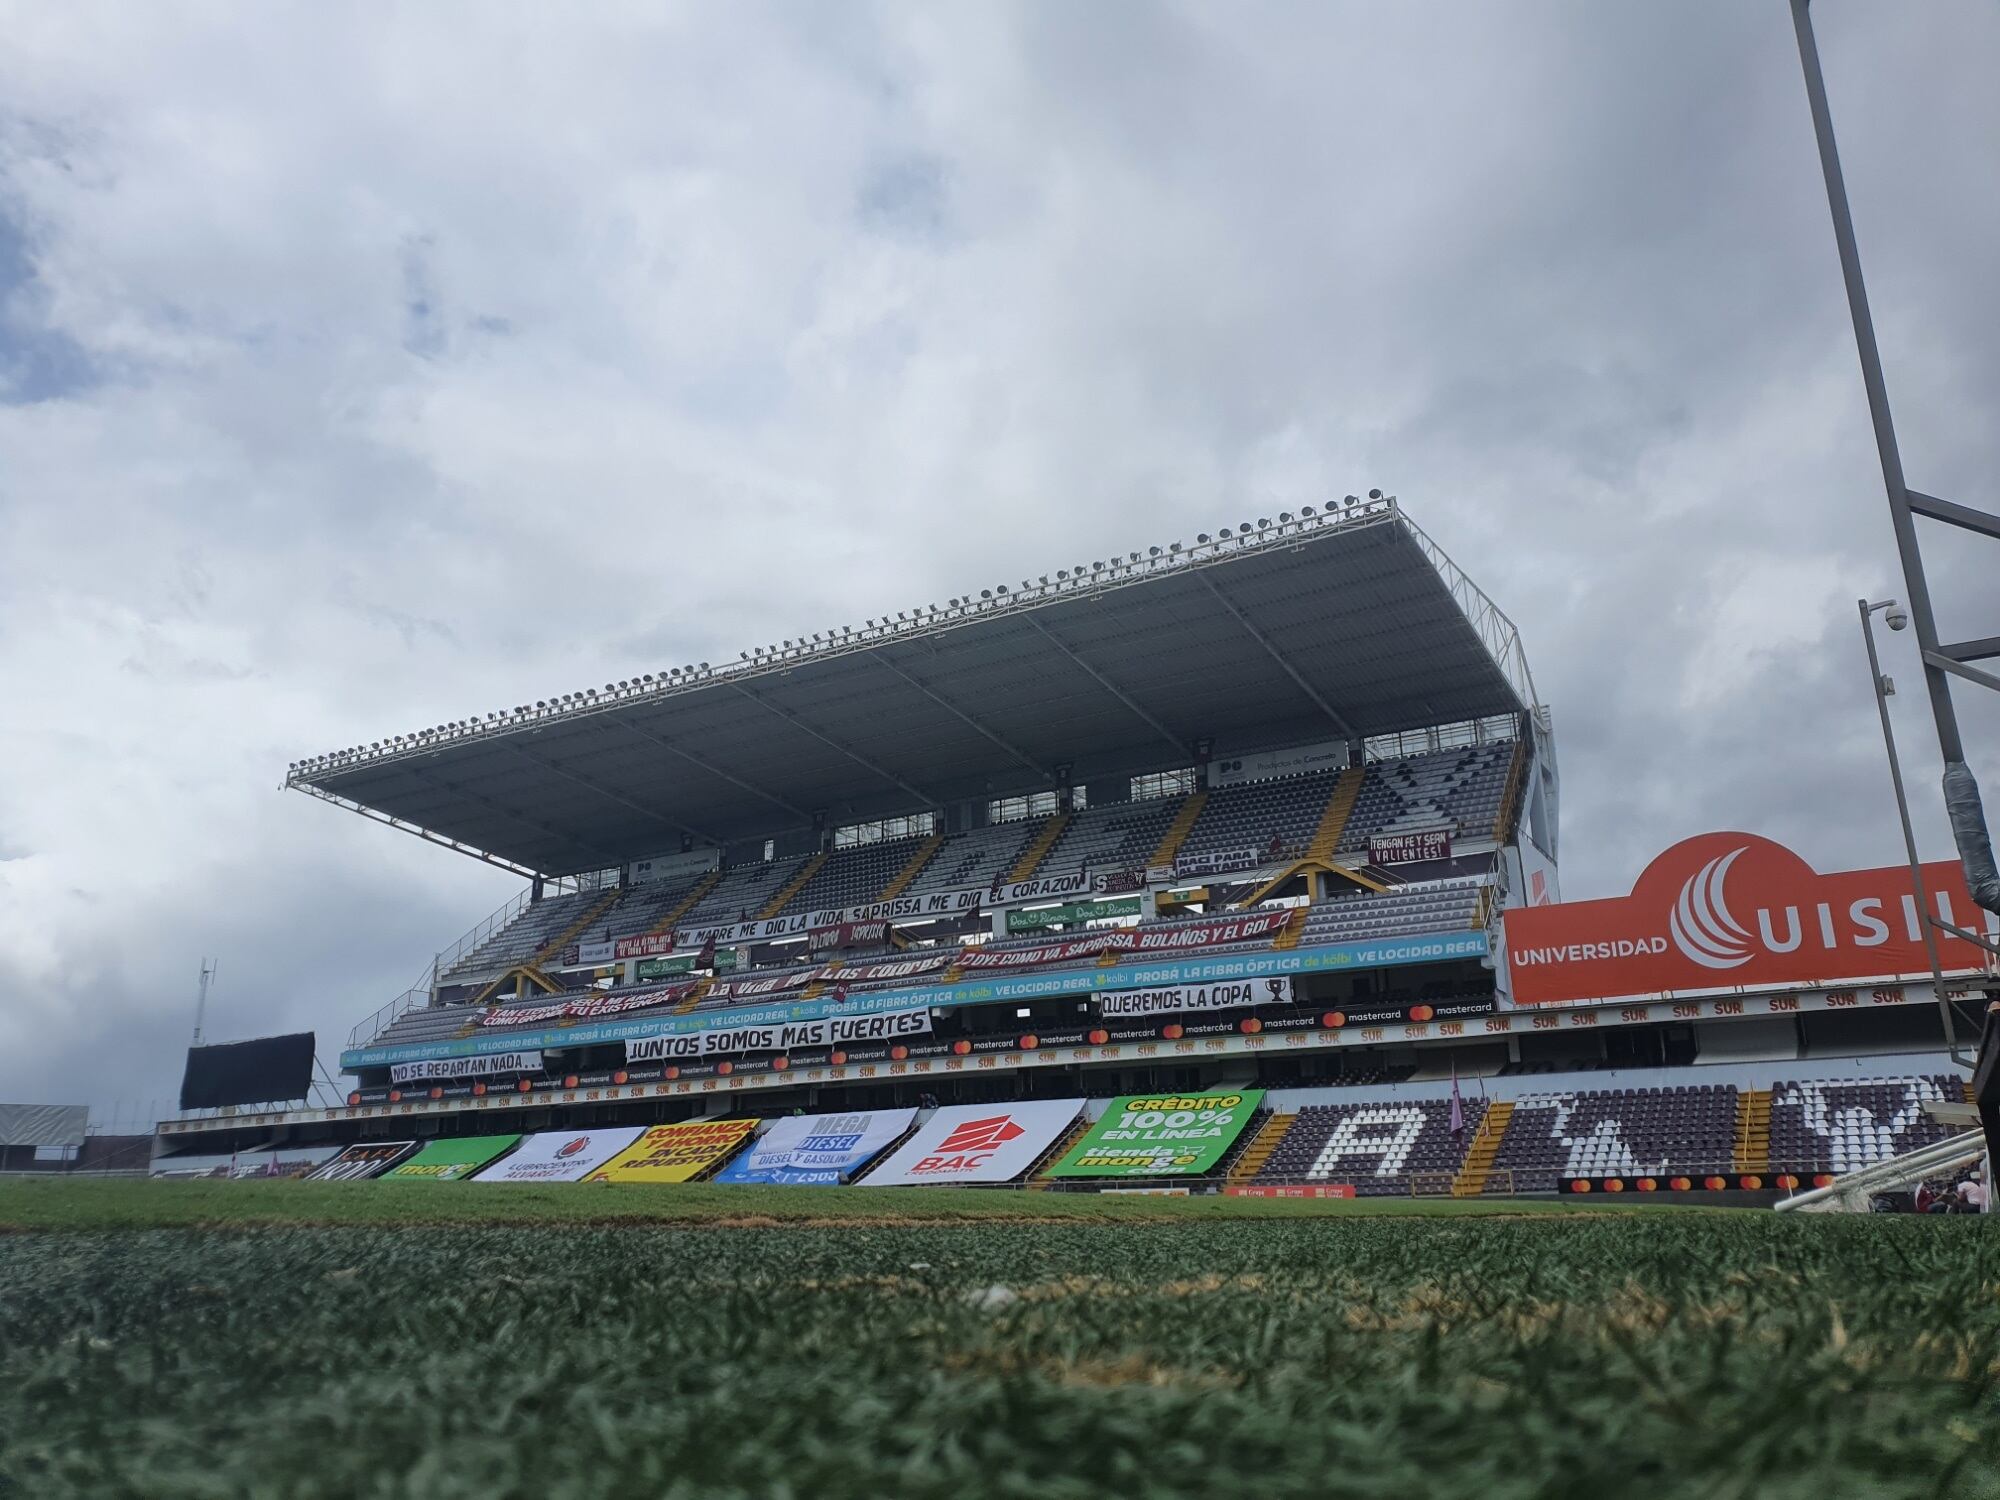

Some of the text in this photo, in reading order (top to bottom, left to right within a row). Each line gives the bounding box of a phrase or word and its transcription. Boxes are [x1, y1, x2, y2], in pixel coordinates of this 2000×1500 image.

[1405, 836, 1415, 848] FE
[1416, 835, 1423, 846] Y
[1423, 832, 1446, 846] SEAN
[1214, 851, 1252, 862] PARA
[1376, 844, 1442, 862] VALIENTES!
[678, 932, 691, 944] MI
[739, 922, 758, 937] ME
[765, 919, 786, 934] DIO
[789, 915, 808, 930] LA
[813, 908, 846, 926] VIDA
[853, 898, 921, 920] SAPRISSA
[928, 893, 951, 910] ME
[1757, 890, 1976, 954] UISIL
[1140, 929, 1208, 948] BOLAÑOS
[1210, 927, 1224, 941] Y
[1223, 925, 1239, 937] EL
[1241, 918, 1270, 936] GOL
[1514, 936, 1668, 967] UNIVERSIDAD
[1134, 968, 1180, 983] PROBÁ
[1184, 965, 1203, 978] LA
[1203, 961, 1244, 976] FIBRA
[1246, 956, 1301, 973] ÓPTICA
[1356, 945, 1441, 963] VELOCIDAD
[1446, 938, 1485, 954] REAL
[860, 998, 877, 1010] LA
[878, 994, 911, 1008] FIBRA
[996, 979, 1060, 996] VELOCIDAD
[1062, 976, 1093, 990] REAL
[1102, 983, 1252, 1015] QUEREMOS LA COPA
[1825, 992, 1857, 1007] SUR
[1872, 988, 1904, 1004] SUR
[1436, 1003, 1492, 1016] mastercard
[1673, 1003, 1698, 1017] SUR
[1714, 1000, 1740, 1015] SUR
[1769, 997, 1797, 1011] SUR
[1348, 1010, 1402, 1022] mastercard
[1572, 1012, 1597, 1025] SUR
[1622, 1007, 1647, 1022] SUR
[1186, 1022, 1233, 1034] mastercard
[1264, 1016, 1315, 1029] mastercard
[1486, 1018, 1510, 1032] SUR
[1532, 1016, 1557, 1029] SUR
[630, 1010, 928, 1060] JUNTOS SOMOS MÁS FUERTES
[1111, 1028, 1156, 1040] mastercard
[1361, 1030, 1382, 1042] SUR
[1440, 1024, 1462, 1036] SUR
[974, 1039, 1014, 1050] mastercard
[1040, 1033, 1083, 1045] mastercard
[849, 1050, 886, 1061] mastercard
[911, 1045, 948, 1056] mastercard
[1101, 1048, 1118, 1060] SUR
[734, 1061, 769, 1071] mastercard
[790, 1055, 826, 1065] mastercard
[945, 1059, 961, 1070] SUR
[393, 1067, 407, 1081] NO
[410, 1064, 424, 1078] SE
[427, 1058, 486, 1077] REPARTAN
[681, 1066, 715, 1076] mastercard
[829, 1067, 846, 1079] SUR
[890, 1063, 906, 1075] SUR
[703, 1079, 718, 1090] SUR
[586, 1089, 600, 1101] SUR
[1126, 1096, 1242, 1112] CRÉDITO
[809, 1114, 872, 1135] MEGA
[1118, 1108, 1233, 1129] 100%
[645, 1120, 758, 1139] CONFIANZA
[1100, 1126, 1223, 1140] EN LÍNEA
[655, 1133, 743, 1149] AHORRO
[800, 1135, 860, 1150] DIESEL
[648, 1144, 730, 1159] EN CADA
[758, 1152, 792, 1165] DIESEL
[794, 1152, 804, 1162] Y
[1085, 1145, 1174, 1158] tienda
[619, 1154, 718, 1168] REPUESTO
[910, 1153, 994, 1171] BAC
[1075, 1155, 1198, 1169] monge
